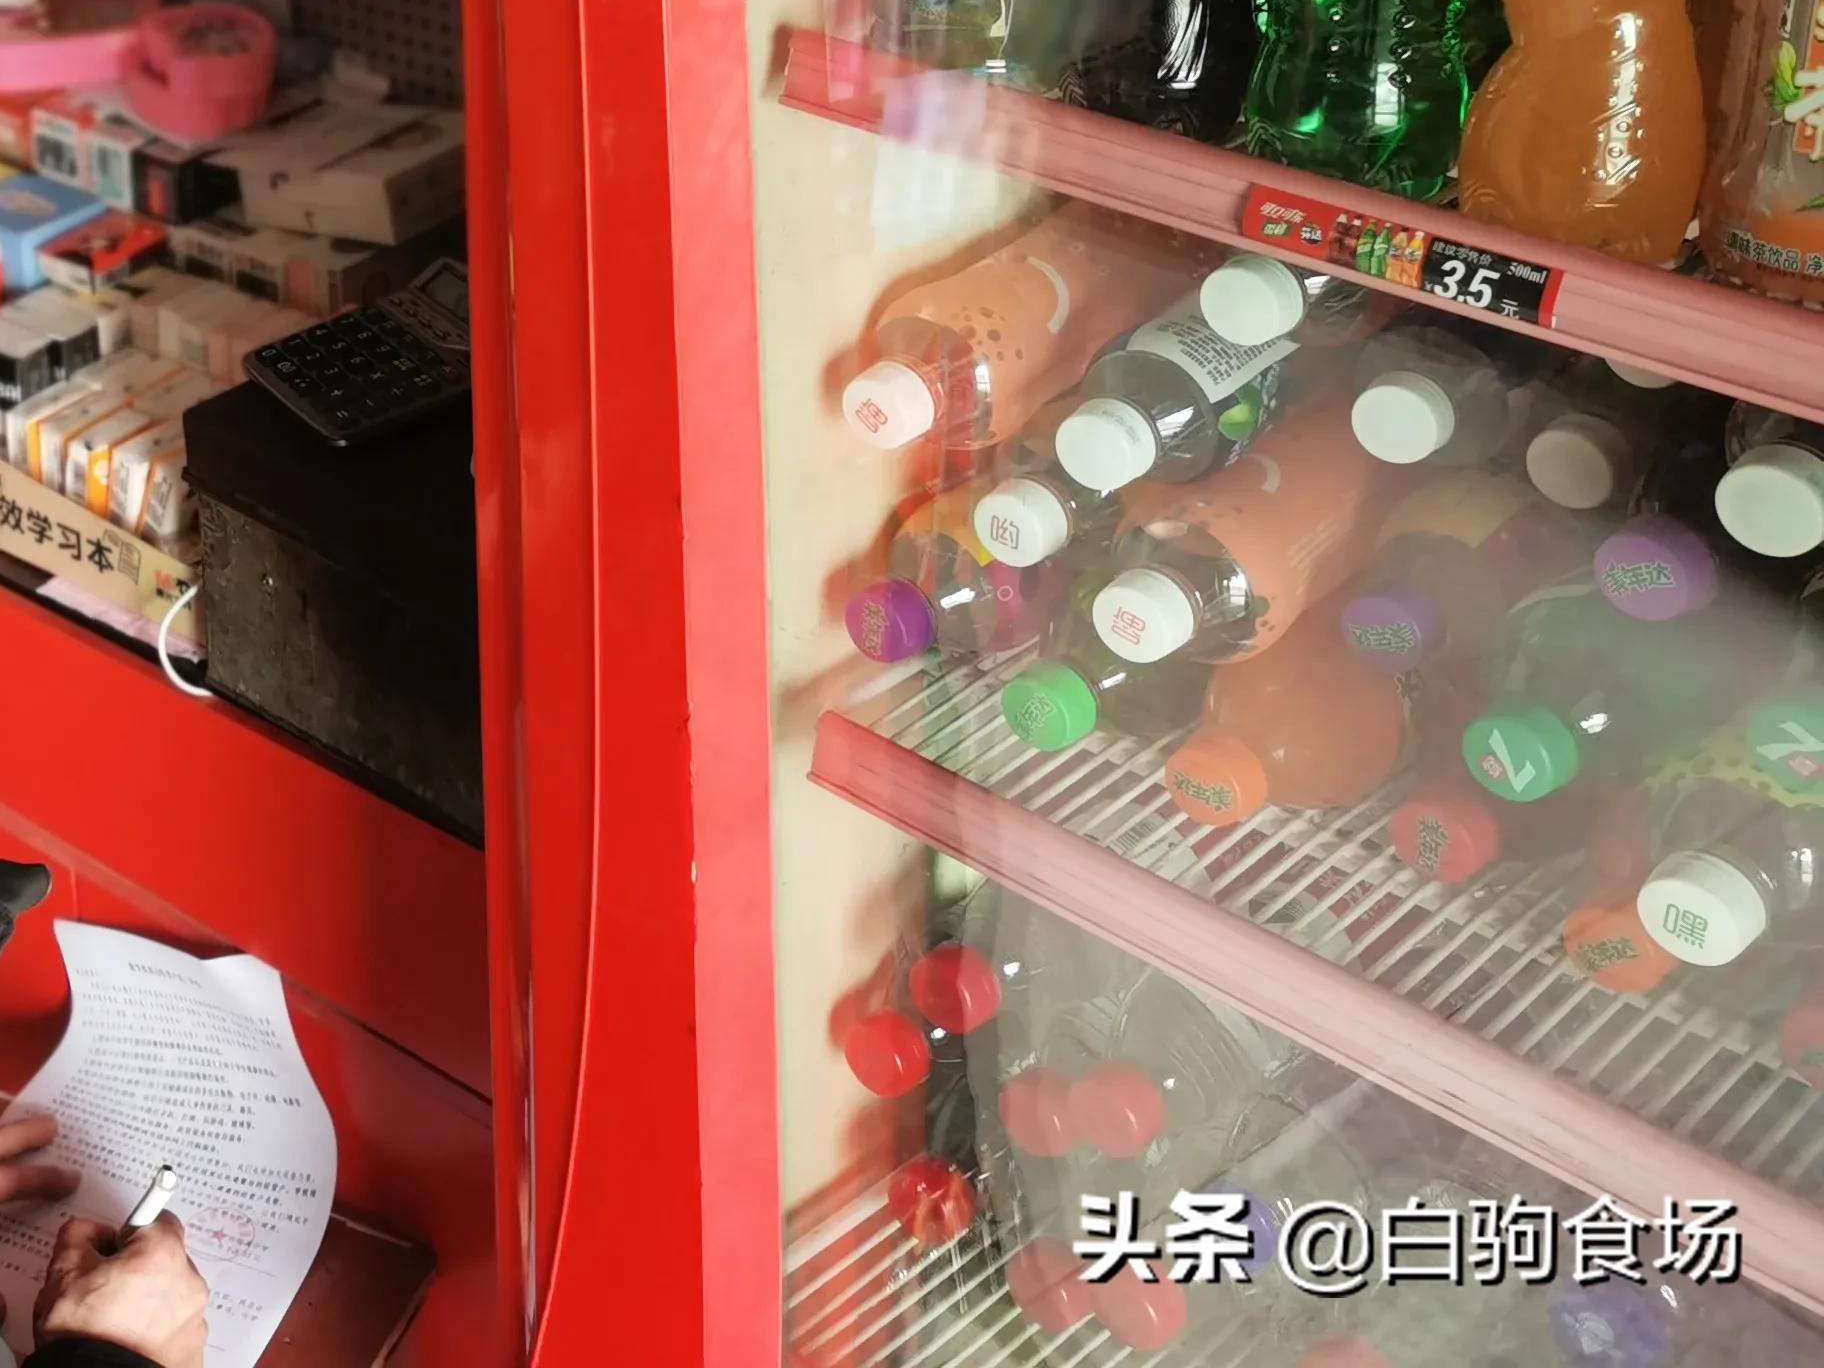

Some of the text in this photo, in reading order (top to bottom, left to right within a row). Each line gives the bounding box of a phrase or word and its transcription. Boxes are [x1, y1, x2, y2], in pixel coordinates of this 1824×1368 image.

[1432, 241, 1493, 266] 建议零售价
[1507, 262, 1548, 284] 500ml
[1500, 298, 1520, 320] 元
